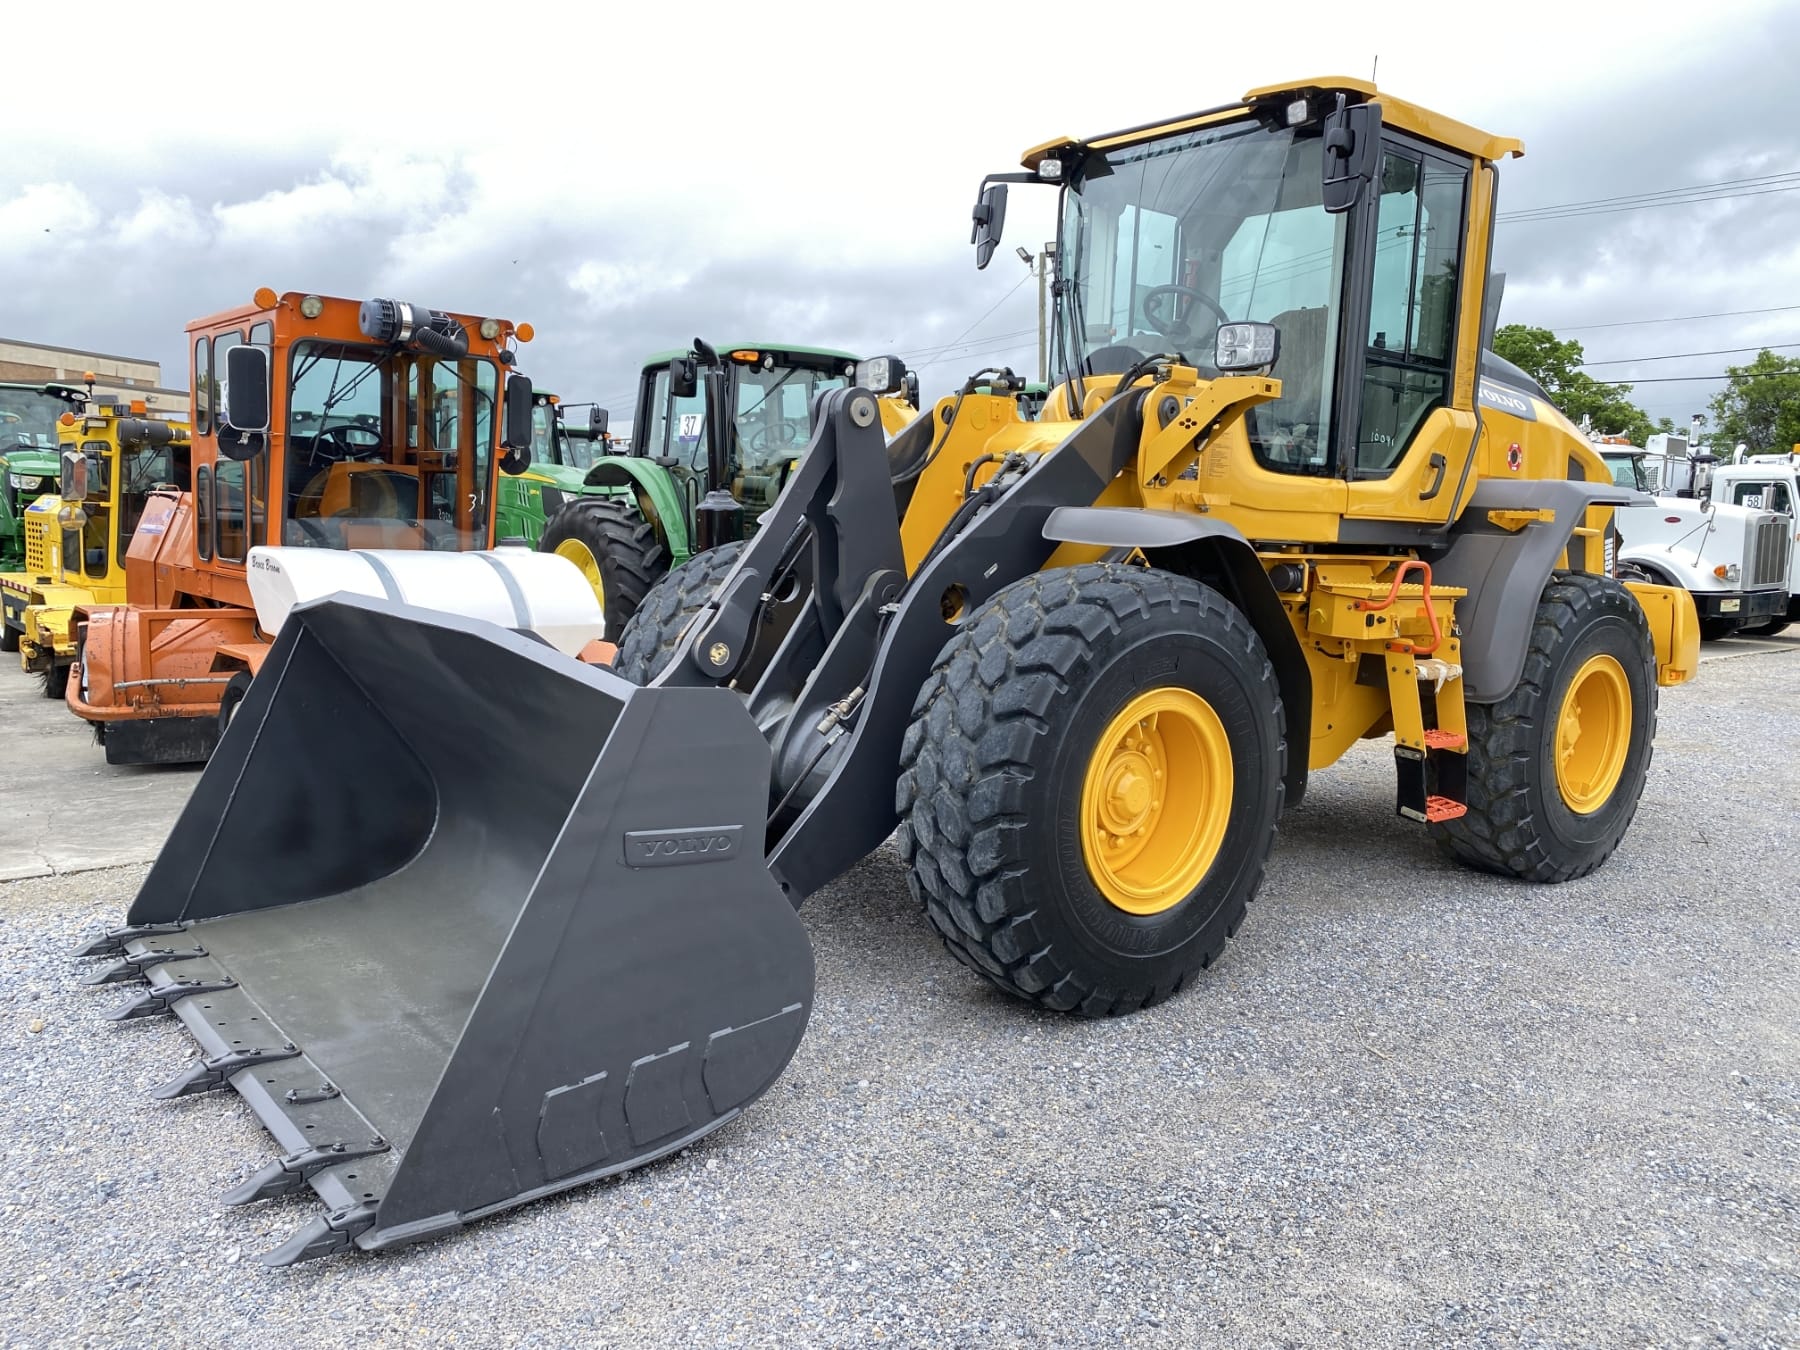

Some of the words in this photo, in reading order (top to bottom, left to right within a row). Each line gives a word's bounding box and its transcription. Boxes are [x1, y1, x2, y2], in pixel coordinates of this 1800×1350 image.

[684, 415, 697, 436] 37
[1747, 495, 1759, 508] 58
[636, 836, 732, 857] VOLVO
